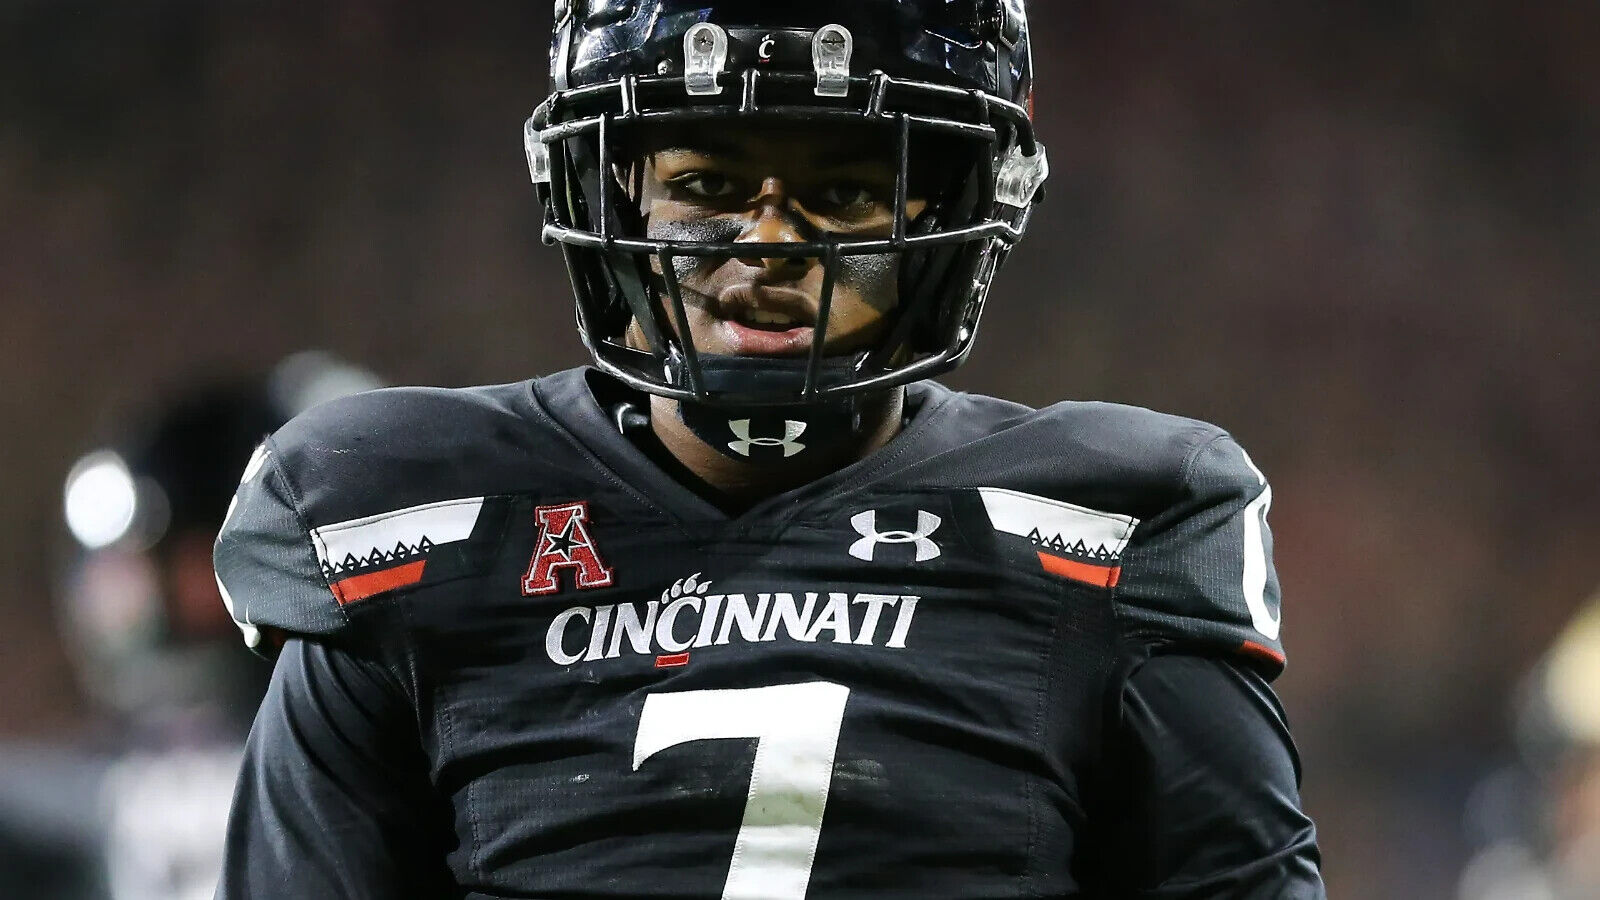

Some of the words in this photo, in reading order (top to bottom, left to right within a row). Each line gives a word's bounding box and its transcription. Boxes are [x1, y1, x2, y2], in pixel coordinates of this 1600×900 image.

[758, 39, 776, 59] C
[522, 502, 613, 595] A
[545, 591, 921, 666] CINCINNATI
[632, 681, 851, 900] 7
